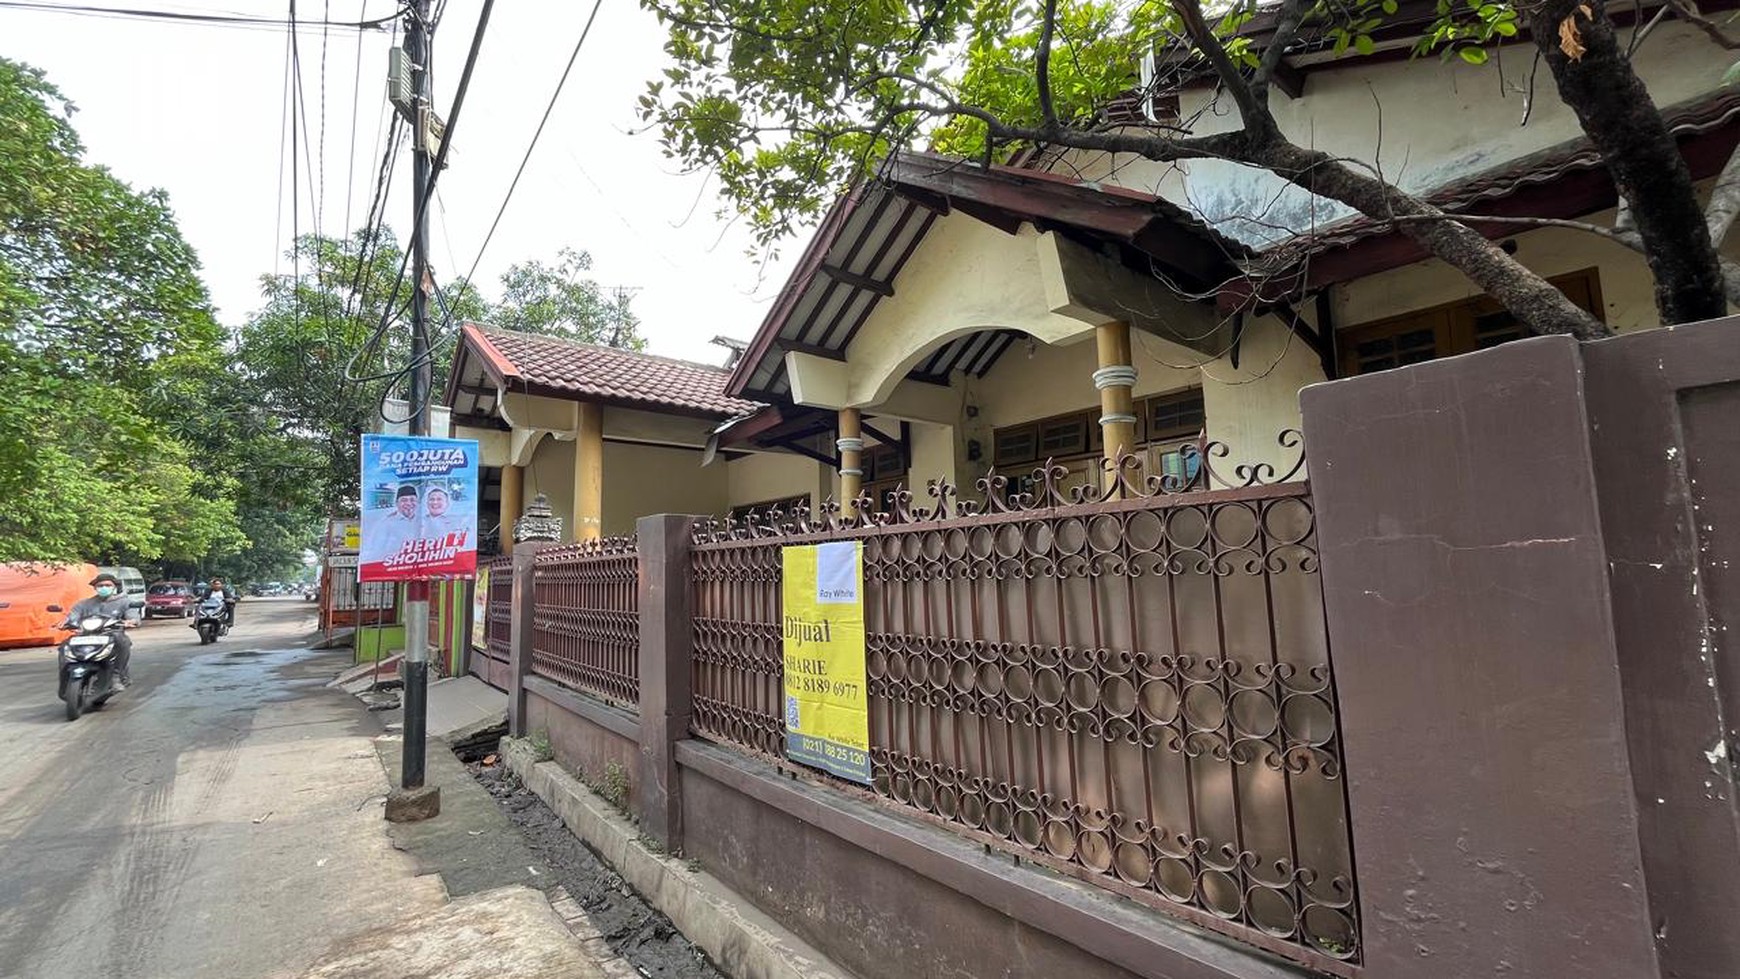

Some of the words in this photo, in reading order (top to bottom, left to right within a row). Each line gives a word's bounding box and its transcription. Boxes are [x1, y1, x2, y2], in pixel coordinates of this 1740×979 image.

[395, 466, 430, 475] SETIAP
[430, 464, 449, 472] RW
[401, 537, 442, 553] HERI
[383, 548, 455, 566] SHOLIHIN
[819, 589, 832, 599] Ray
[833, 588, 854, 598] White
[785, 615, 831, 646] Dijual
[785, 654, 827, 675] SHARIE
[803, 677, 830, 693] 8189
[833, 683, 858, 700] 6977
